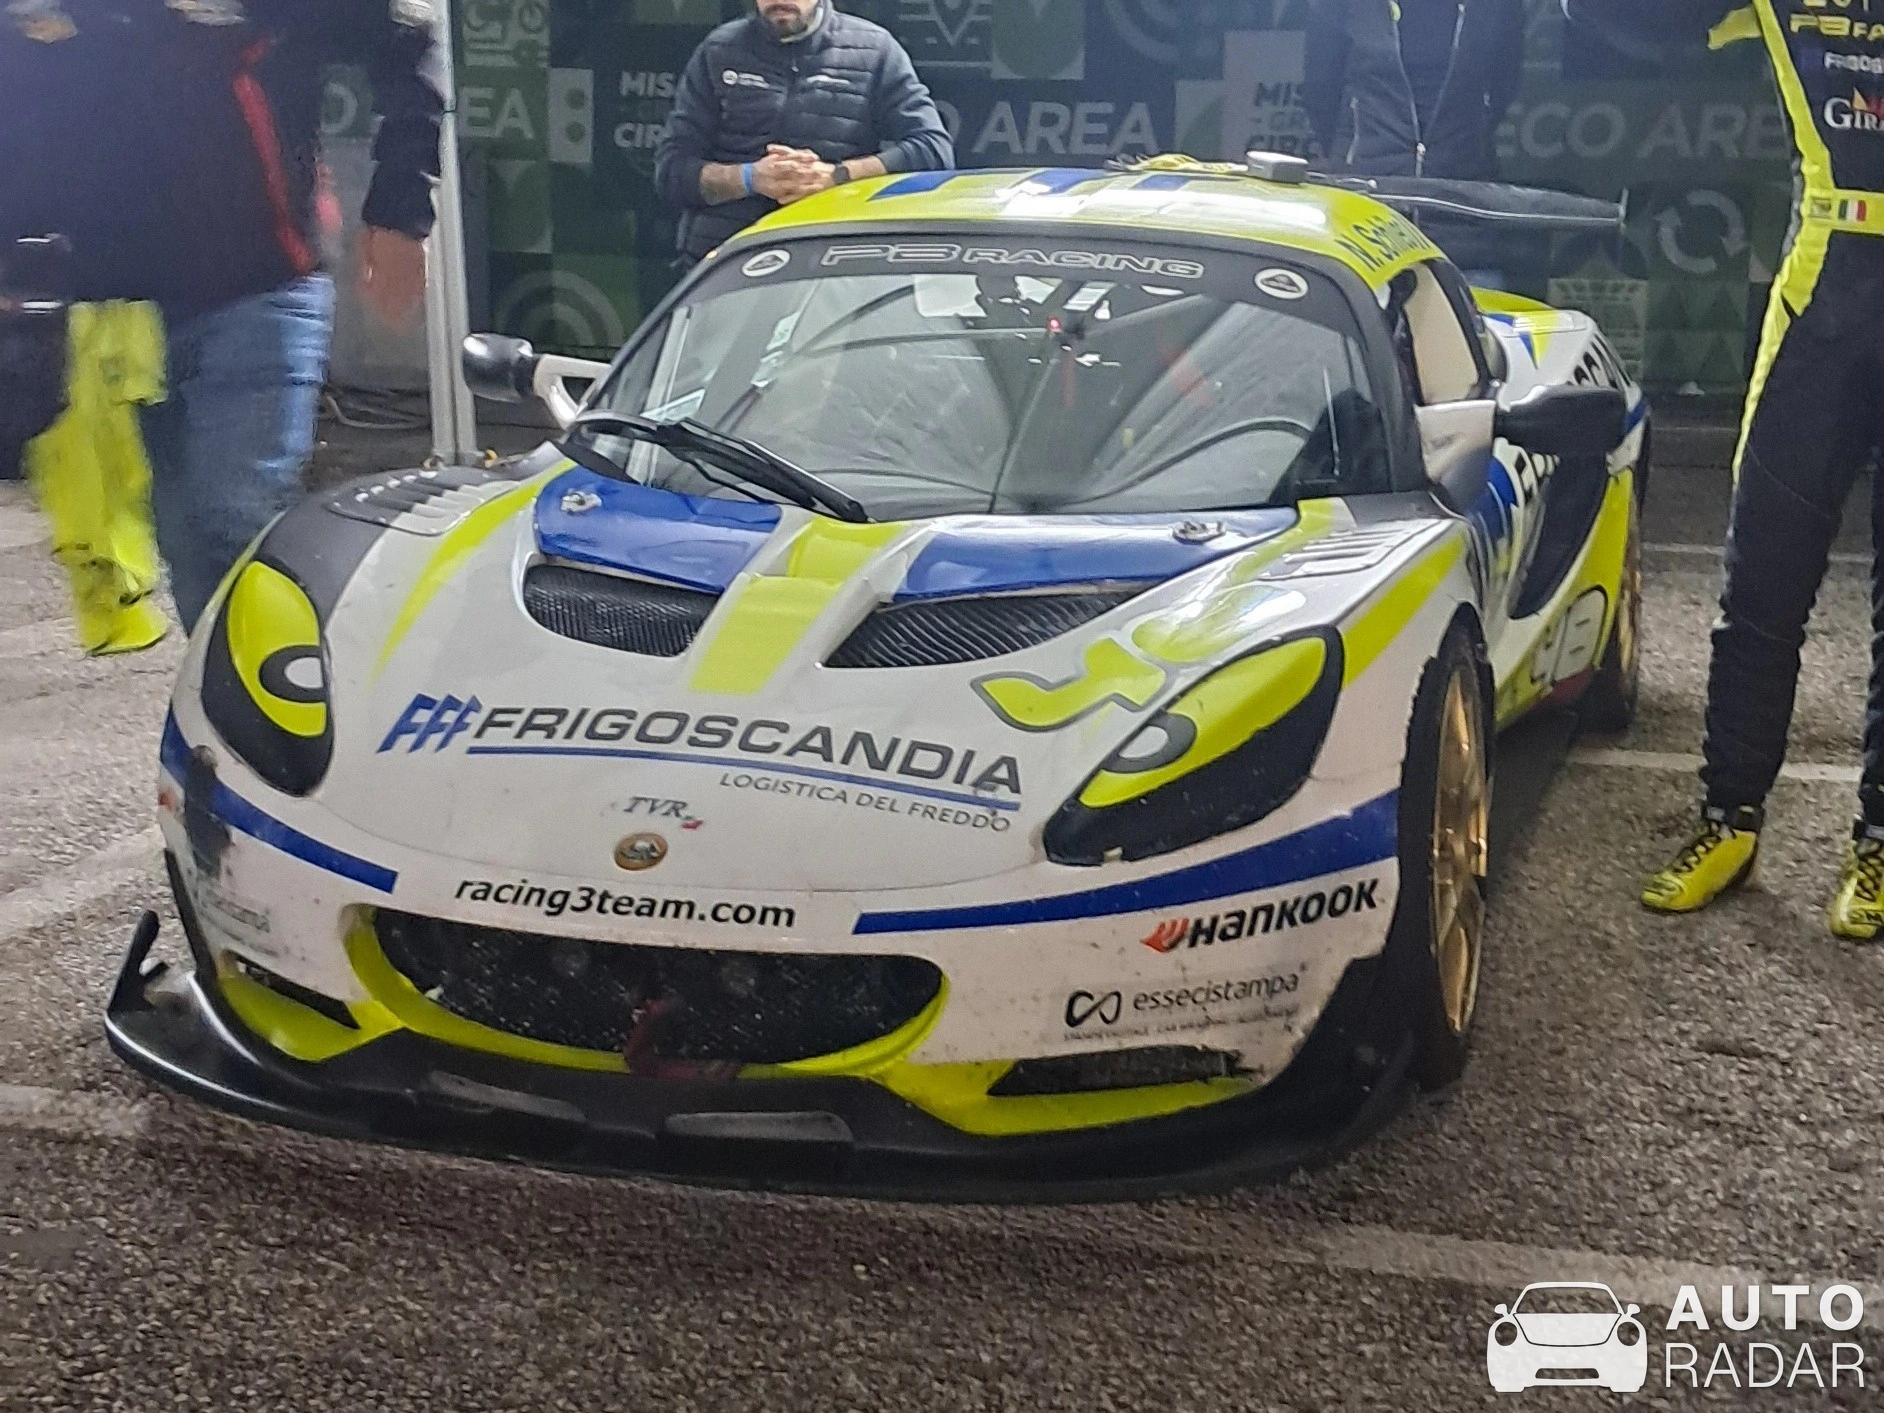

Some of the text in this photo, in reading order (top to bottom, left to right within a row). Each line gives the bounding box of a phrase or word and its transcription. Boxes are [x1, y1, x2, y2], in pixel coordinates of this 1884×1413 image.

[972, 101, 1160, 153] AREA
[961, 247, 1206, 280] RACING
[473, 706, 1022, 795] FRIGOSCANDIA
[719, 772, 1012, 833] LOGISTICA DEL FREDDO
[454, 879, 797, 928] racing3team.com
